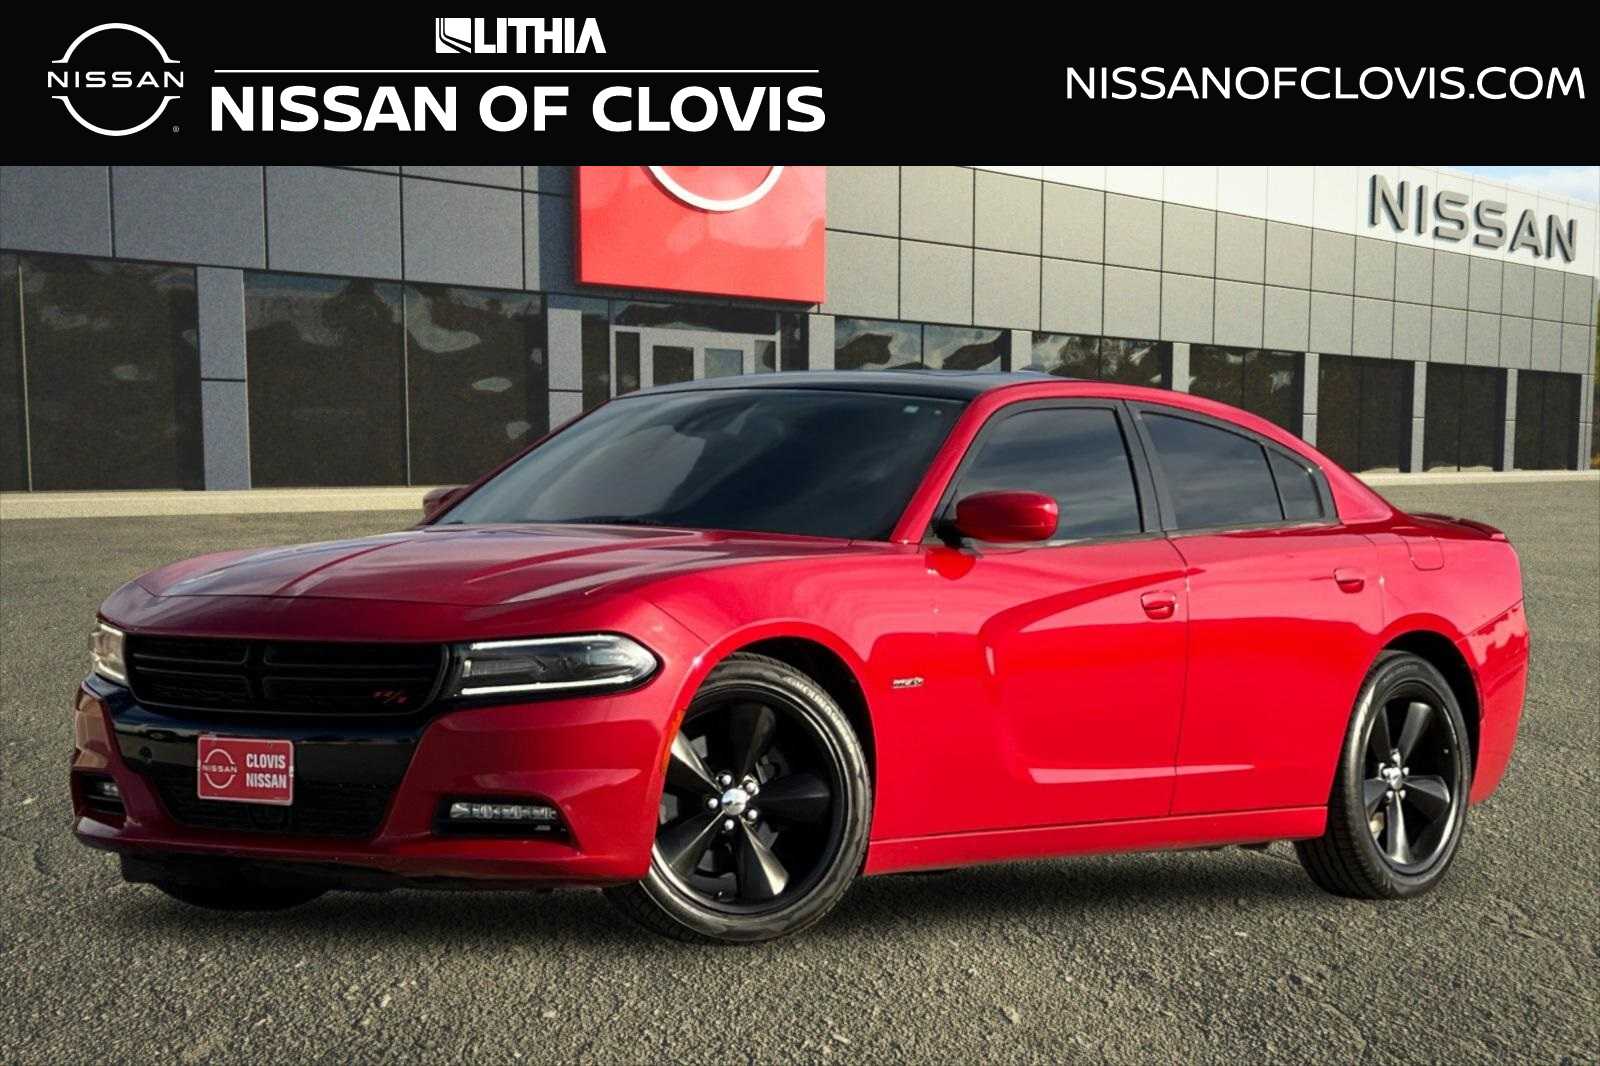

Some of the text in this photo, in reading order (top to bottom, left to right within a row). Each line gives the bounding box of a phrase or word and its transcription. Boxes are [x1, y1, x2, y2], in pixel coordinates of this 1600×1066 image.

[1369, 174, 1577, 262] NISSAN
[202, 764, 238, 773] NISSAN
[246, 753, 286, 769] CLOVIS
[246, 773, 288, 789] NISSAN
